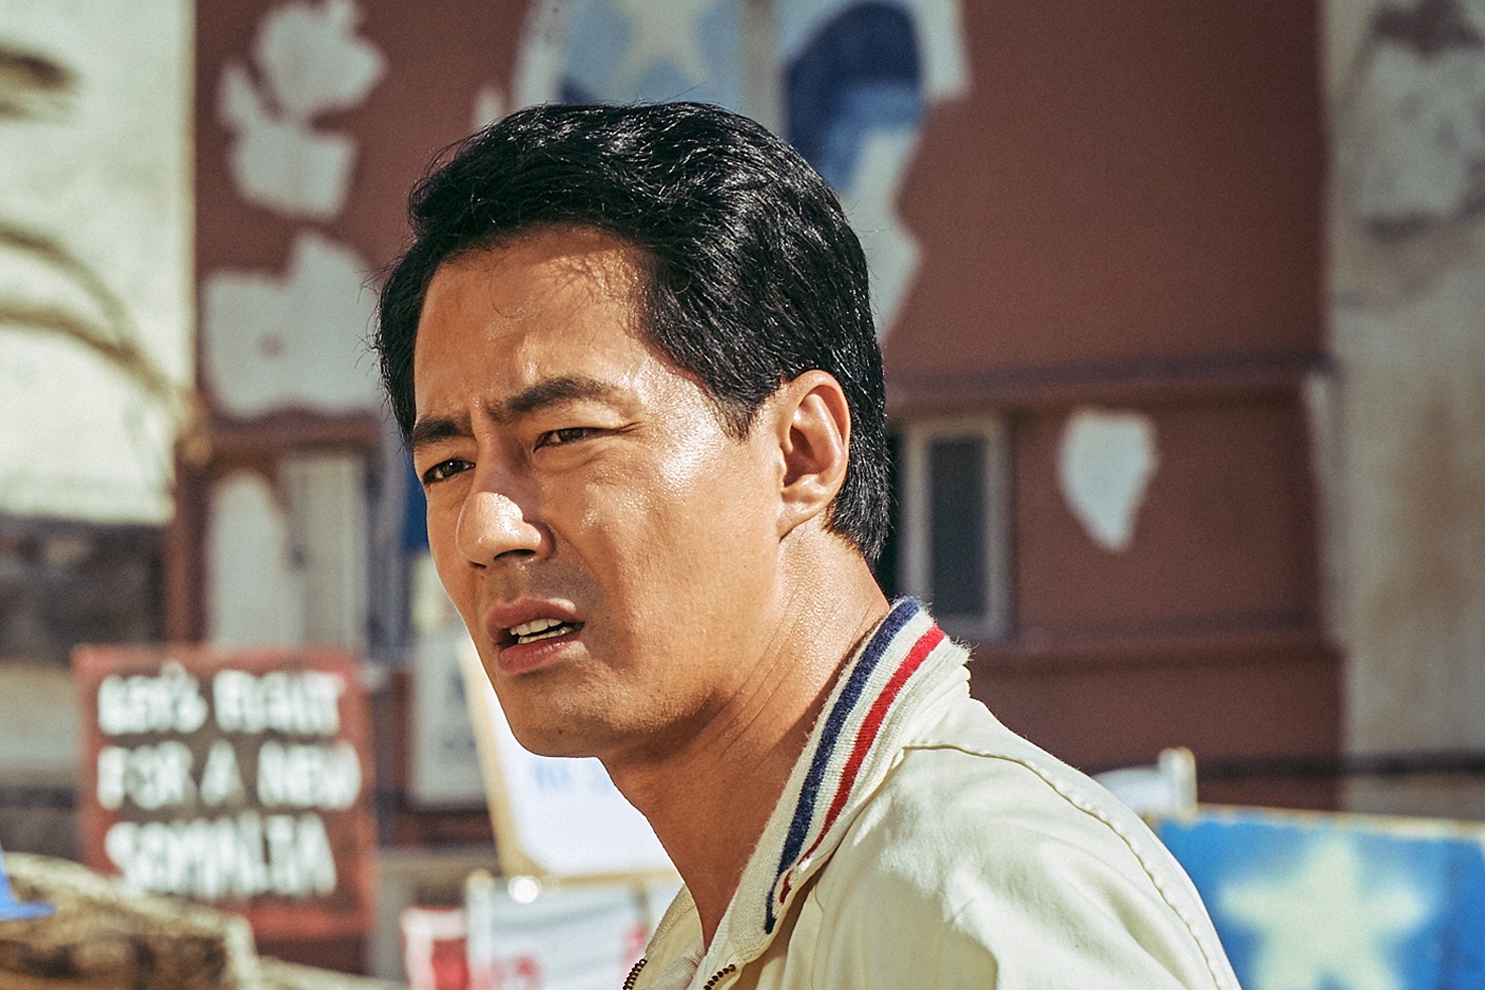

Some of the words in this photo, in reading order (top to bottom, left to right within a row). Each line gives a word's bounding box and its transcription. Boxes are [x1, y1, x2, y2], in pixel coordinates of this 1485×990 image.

[97, 664, 207, 735] LET'S
[97, 740, 195, 811] FOR
[200, 740, 245, 808] A
[257, 740, 362, 810] NEW
[105, 813, 337, 899] SOMALIA
